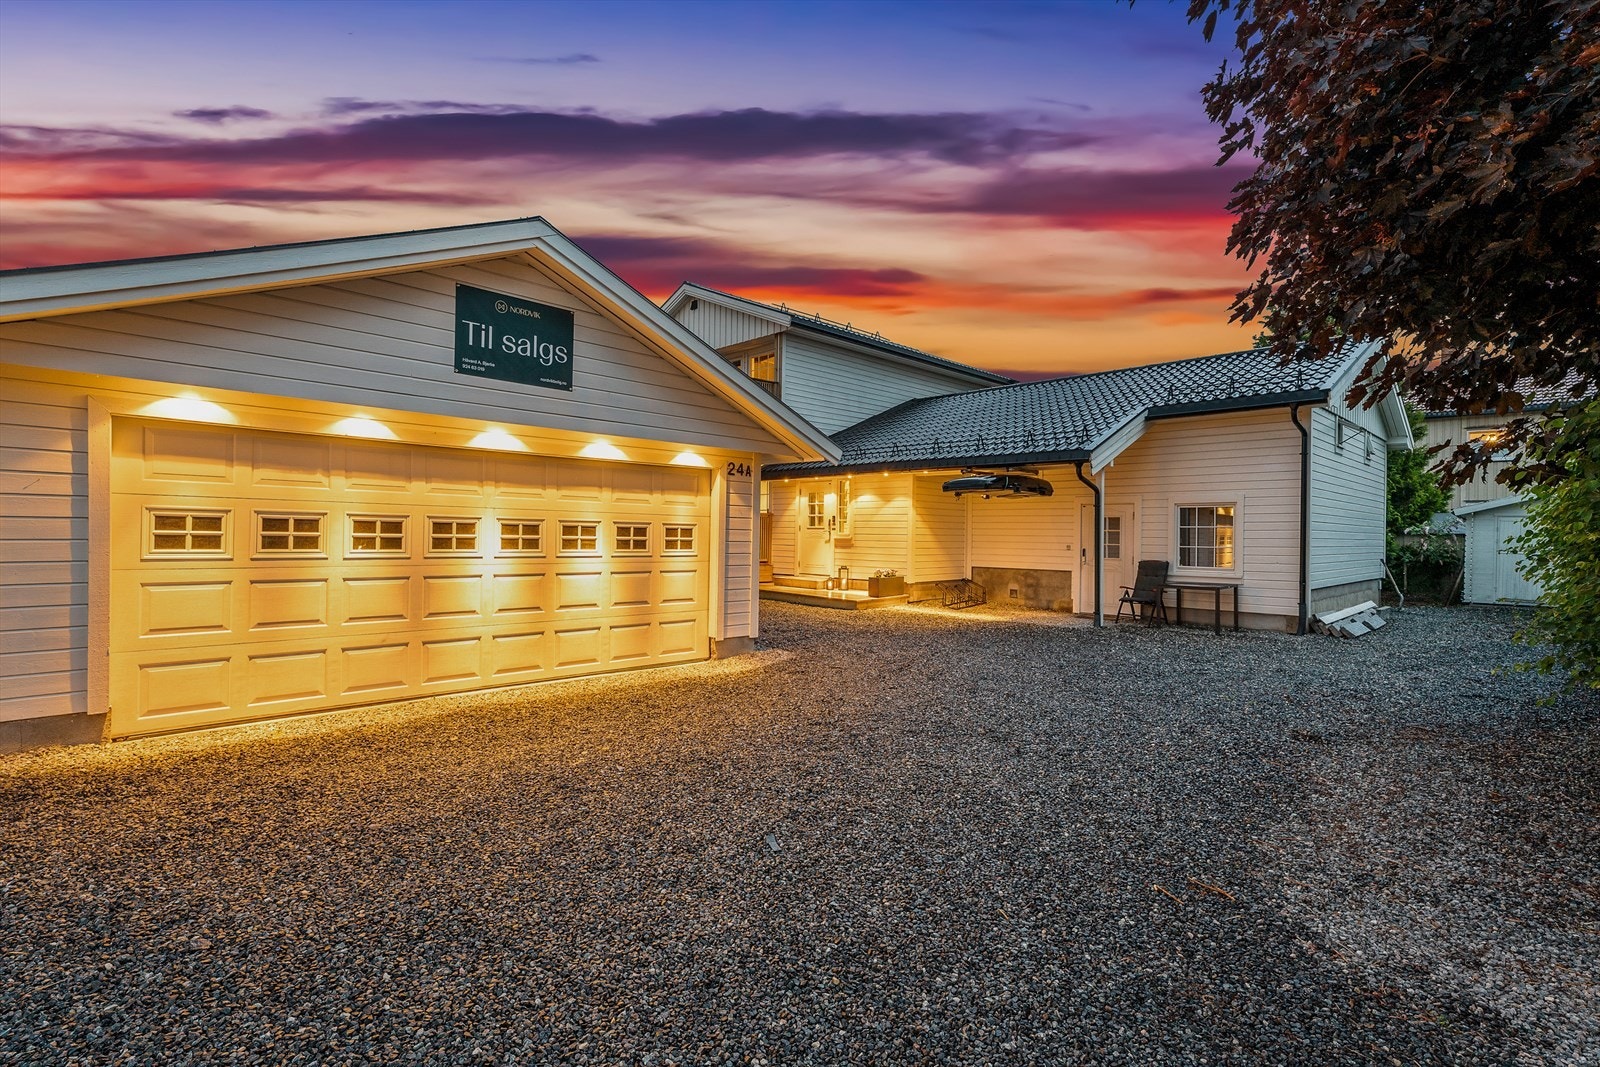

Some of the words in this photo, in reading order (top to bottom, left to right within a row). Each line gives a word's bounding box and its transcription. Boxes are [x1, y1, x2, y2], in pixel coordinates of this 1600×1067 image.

[509, 306, 541, 319] NORDVIK
[462, 319, 493, 350] Til
[501, 335, 568, 366] salgs
[727, 461, 752, 476] 24A
